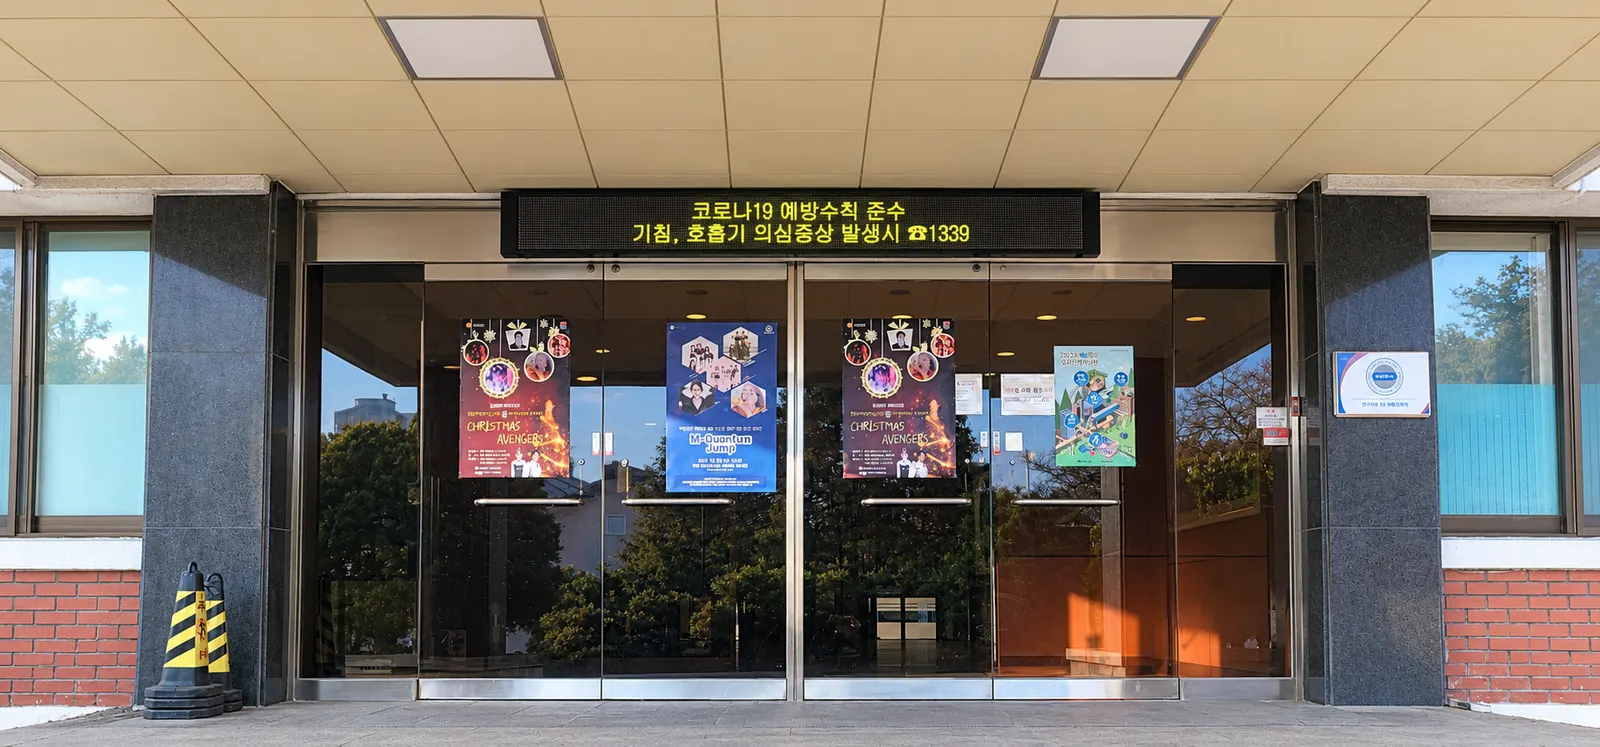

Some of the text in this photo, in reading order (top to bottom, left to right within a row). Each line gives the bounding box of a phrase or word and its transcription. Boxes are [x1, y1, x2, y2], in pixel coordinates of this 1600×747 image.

[692, 201, 906, 221] 코로나19 예방수칙 준수
[632, 223, 679, 245] 기침,
[687, 223, 745, 244] 호흡기
[841, 223, 899, 244] 발생시
[467, 420, 521, 432] CHRISTMAS
[850, 420, 905, 432] CHRISTMAS
[496, 433, 544, 445] AVENGERS
[881, 432, 929, 445] AVENGERS
[705, 443, 736, 456] Jump
